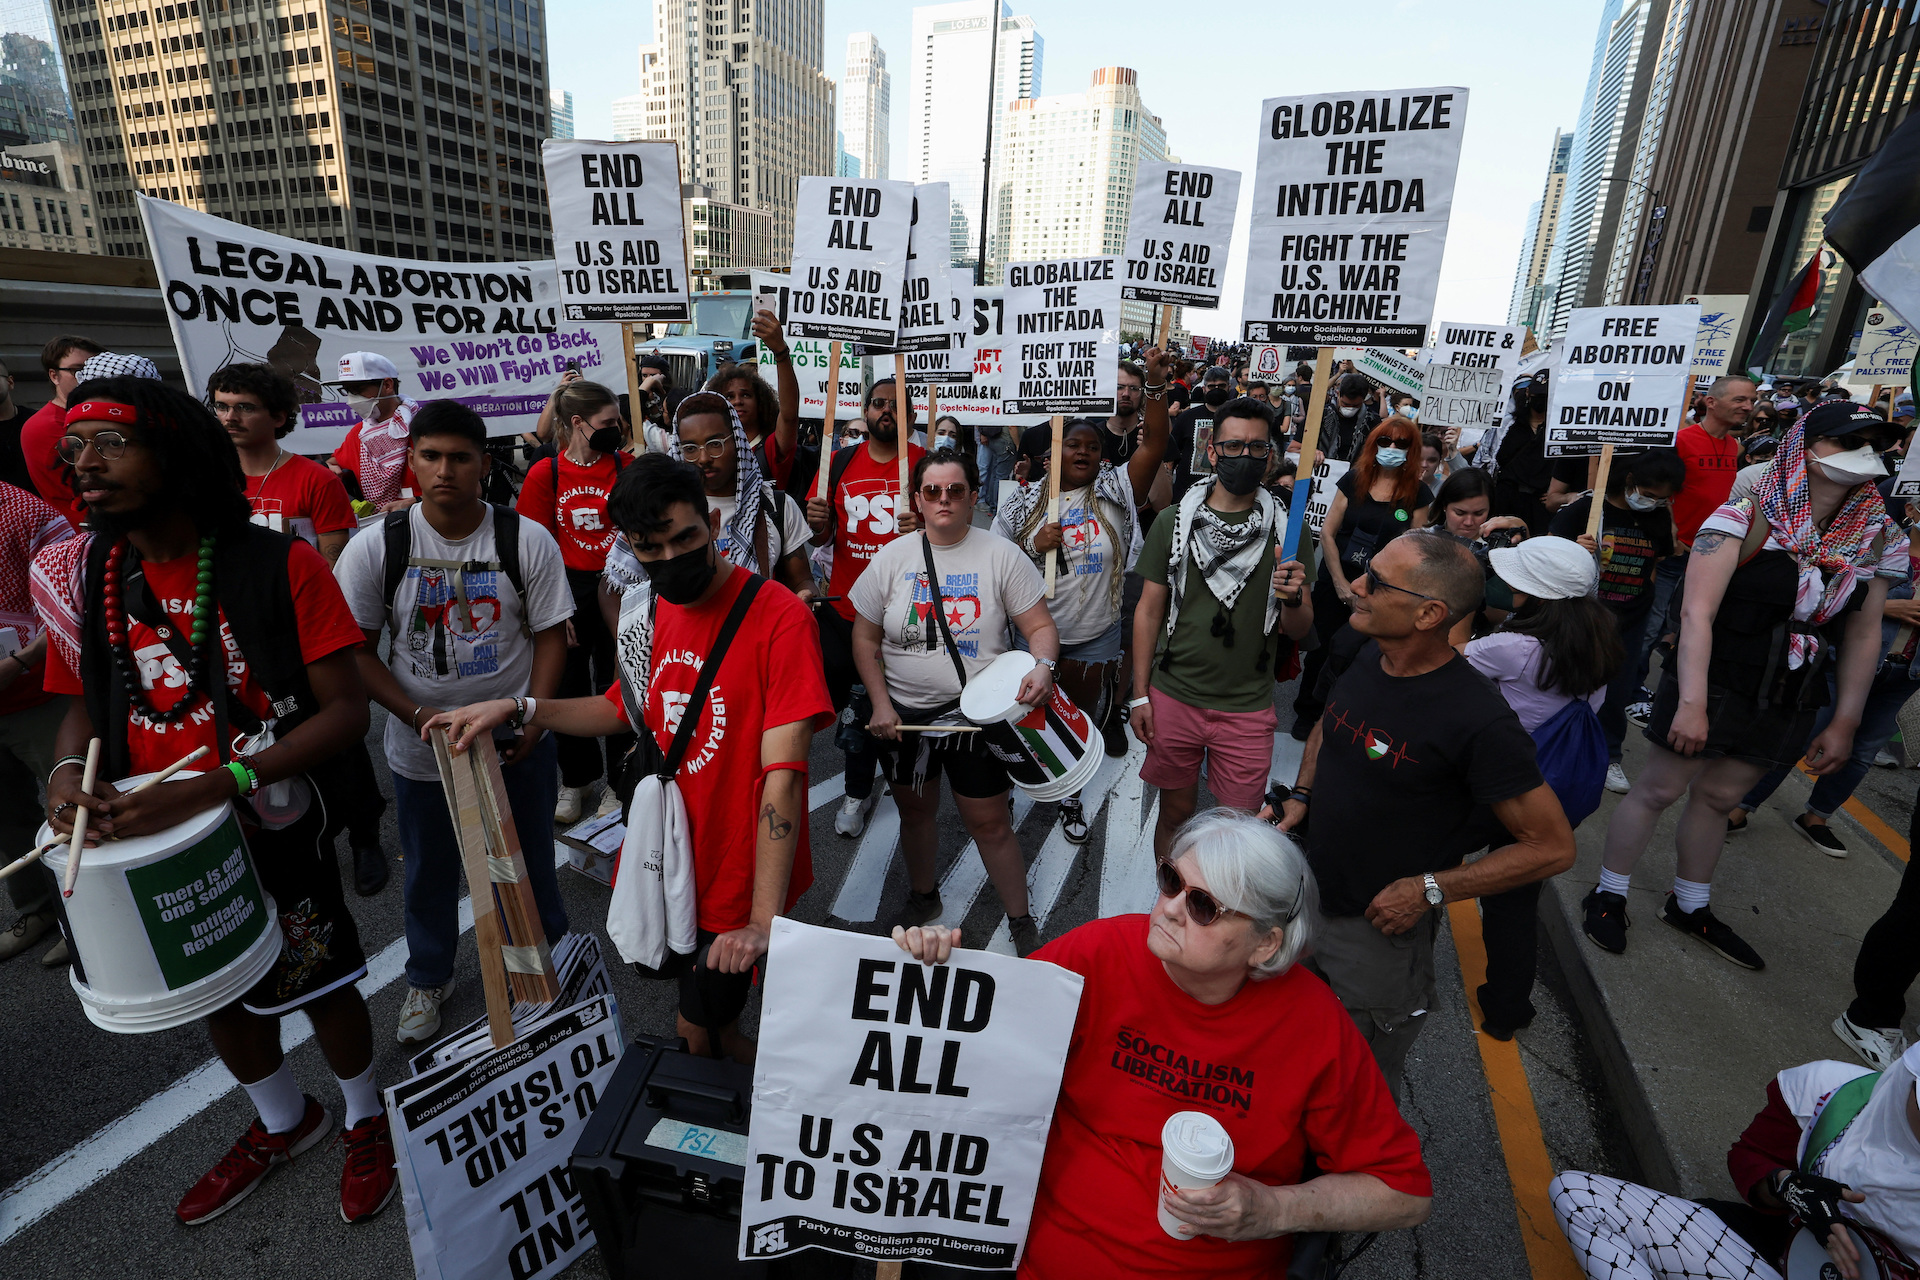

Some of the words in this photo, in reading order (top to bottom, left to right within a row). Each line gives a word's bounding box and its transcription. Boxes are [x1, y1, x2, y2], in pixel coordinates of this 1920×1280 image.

[951, 17, 988, 31] LOEWS
[1271, 94, 1453, 140] GLOBALIZE
[0, 151, 50, 175] bune
[581, 154, 643, 188] END
[1325, 140, 1386, 176] THE
[1164, 170, 1214, 199] END
[1276, 178, 1425, 217] INTIFADA
[592, 192, 644, 226] ALL
[828, 186, 882, 218] END
[1163, 199, 1205, 227] ALL
[827, 220, 873, 251] ALL
[1280, 234, 1354, 262] FIGHT
[1360, 234, 1410, 262] THE
[575, 240, 614, 267] U.S
[622, 240, 660, 266] AID
[1143, 239, 1174, 261] U.S
[1178, 243, 1211, 265] AID
[1637, 223, 1663, 294] HYATT
[187, 236, 341, 289] LEGAL
[350, 265, 533, 303] ABORTION
[562, 269, 591, 295] TO
[598, 268, 679, 294] ISRAEL
[808, 266, 840, 290] U.S
[845, 269, 882, 294] AID
[1010, 260, 1114, 287] GLOBALIZE
[1127, 260, 1149, 280] TO
[1154, 262, 1217, 288] ISRAEL
[1281, 264, 1328, 291] U.S.
[1339, 265, 1401, 291] WAR
[167, 280, 302, 326] ONCE
[315, 297, 402, 332] AND
[415, 303, 485, 334] FOR
[493, 307, 557, 334] ALL!
[588, 305, 603, 313] Party
[612, 304, 641, 312] Socialism
[792, 291, 815, 313] TO
[820, 292, 892, 321] ISRAEL
[1043, 286, 1078, 308] THE
[1272, 294, 1401, 321] MACHINE!
[567, 307, 586, 320] PSL
[614, 311, 652, 319] @pslchicago
[1017, 308, 1105, 335] INTIFADA
[808, 324, 821, 333] Party
[828, 326, 854, 335] Socialism
[864, 328, 891, 338] Liberation
[1248, 326, 1270, 341] PSL
[1276, 324, 1299, 334] Party
[1300, 324, 1312, 333] for
[1313, 324, 1354, 334] Socialism
[1355, 326, 1372, 334] and
[1373, 326, 1418, 335] Liberation
[1314, 334, 1368, 344] @pslchicago
[1445, 328, 1496, 348] UNITE
[1500, 332, 1515, 349] &
[1602, 318, 1660, 337] FREE
[410, 345, 451, 366] We
[451, 339, 515, 361] Won't
[516, 335, 543, 354] Go
[546, 328, 598, 350] Back,
[794, 341, 822, 354] ALL
[1022, 342, 1065, 361] FIGHT
[1068, 341, 1098, 359] THE
[1450, 351, 1500, 370] FIGHT
[1568, 345, 1686, 365] ABORTION
[1698, 349, 1726, 357] FREE
[417, 370, 457, 392] We
[457, 362, 499, 386] Will
[500, 357, 551, 383] Fight
[907, 353, 950, 371] NOW!
[1023, 362, 1052, 379] U.S.
[1057, 360, 1095, 378] WAR
[1359, 356, 1394, 377] STINIAN
[1392, 372, 1424, 392] LIBERAT
[1365, 348, 1408, 373] FEMINISTS
[1408, 368, 1425, 381] FOR
[1692, 358, 1723, 367] STINE
[1856, 367, 1910, 376] PALESTINE
[1885, 358, 1913, 366] FREE
[1019, 380, 1097, 398] MACHINE!
[1252, 372, 1280, 383] HARRIS
[1428, 367, 1497, 394] LIBERATE
[804, 398, 824, 407] Party
[907, 384, 928, 398] 024
[936, 385, 979, 400] CLAUDIA
[980, 387, 990, 400] &
[1598, 382, 1631, 402] ON
[307, 410, 348, 423] PARTY
[940, 404, 990, 414] @pslchicago
[1004, 402, 1020, 414] PSL
[1424, 396, 1494, 425] PALESTINE
[1560, 406, 1669, 428] DEMAND!
[1572, 430, 1589, 438] Party
[1598, 430, 1626, 438] Socialism
[572, 513, 605, 531] PSL
[846, 540, 863, 551] Party
[946, 574, 972, 587] BREAD
[474, 644, 493, 660] PAN
[458, 658, 499, 677] VECINOS
[152, 878, 205, 910] There
[205, 868, 221, 886] is
[222, 845, 243, 874] only
[160, 900, 196, 923] one
[198, 860, 247, 906] solution
[182, 900, 256, 958] Revolution
[190, 894, 246, 939] Intifada
[851, 958, 997, 1034] END
[574, 1003, 603, 1024] PSL
[536, 1040, 549, 1052] for
[548, 1027, 573, 1047] Party
[470, 1042, 531, 1079] @pslchicago
[488, 1050, 535, 1078] Socialism
[570, 1034, 616, 1079] TO
[850, 1031, 970, 1099] ALL
[1116, 1030, 1256, 1089] SOCIALISM
[469, 1073, 487, 1089] and
[1110, 1050, 1253, 1112] LIBERATION
[416, 1085, 469, 1122] Liberation
[424, 1060, 565, 1166] ISRAEL
[538, 1082, 599, 1140] U.S
[465, 1120, 528, 1189] AID
[676, 1127, 719, 1157] PSL
[798, 1114, 884, 1168] U.S
[898, 1130, 990, 1177] AID
[499, 1155, 579, 1234] ALL
[756, 1153, 816, 1203] TO
[832, 1170, 1011, 1228] ISRAEL
[752, 1225, 790, 1254] PSL
[798, 1220, 831, 1237] Party
[832, 1226, 852, 1238] for
[854, 1230, 914, 1246] Socialism
[916, 1235, 941, 1247] and
[942, 1238, 1006, 1255] Liberation
[855, 1242, 934, 1257] @pslchicago
